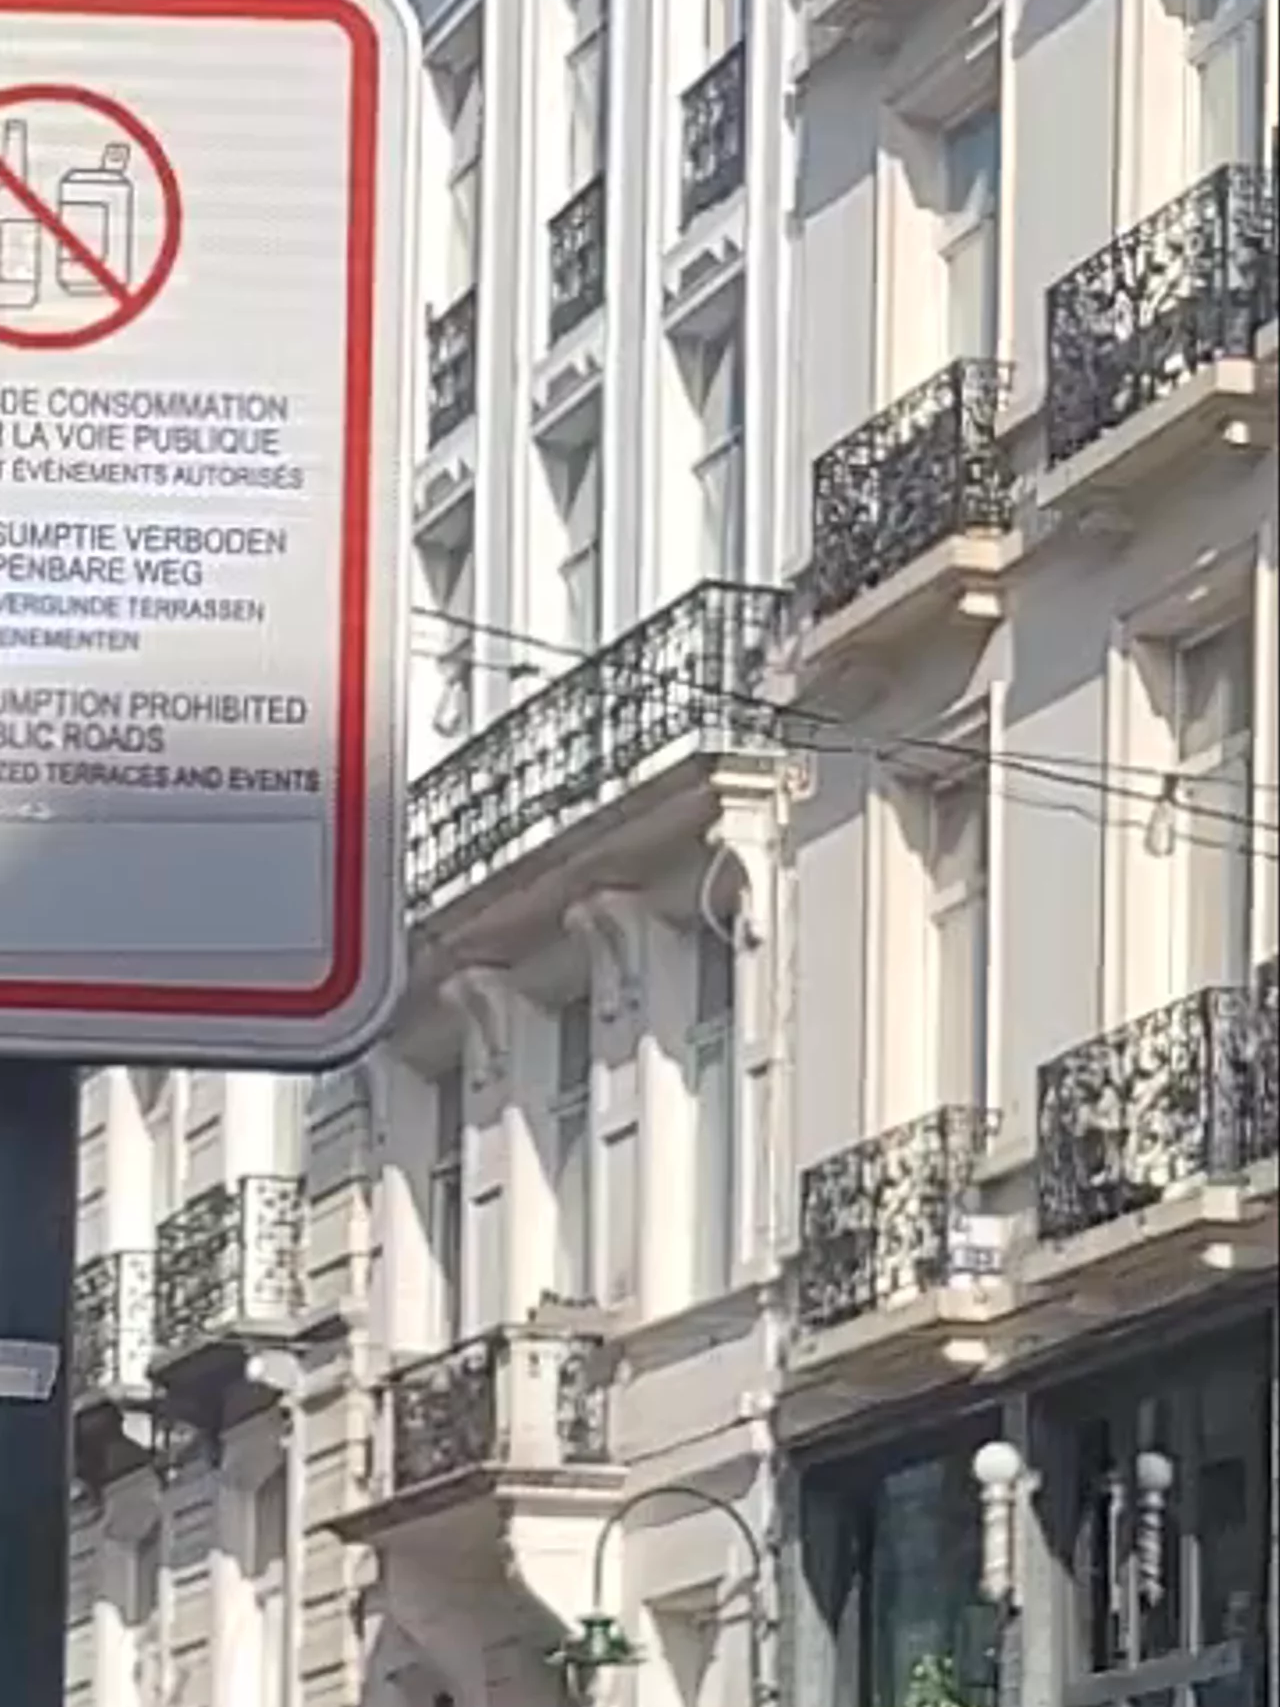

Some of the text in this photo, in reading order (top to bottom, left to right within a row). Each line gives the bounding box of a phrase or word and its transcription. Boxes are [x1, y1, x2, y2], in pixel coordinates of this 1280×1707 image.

[0, 387, 39, 416] DE
[47, 388, 288, 422] CONSOMMATION
[13, 421, 49, 450] LA
[56, 423, 125, 451] VOIE
[133, 425, 281, 456] PUBLIQUE
[124, 524, 288, 555] VERBODEN
[133, 559, 204, 587] WEG
[129, 596, 265, 624] TERRASSEN
[129, 689, 308, 726] PROHIBITED
[63, 723, 166, 754] ROADS
[46, 760, 170, 789] TERRACES
[171, 764, 224, 790] AND
[228, 766, 320, 793] EVENTS
